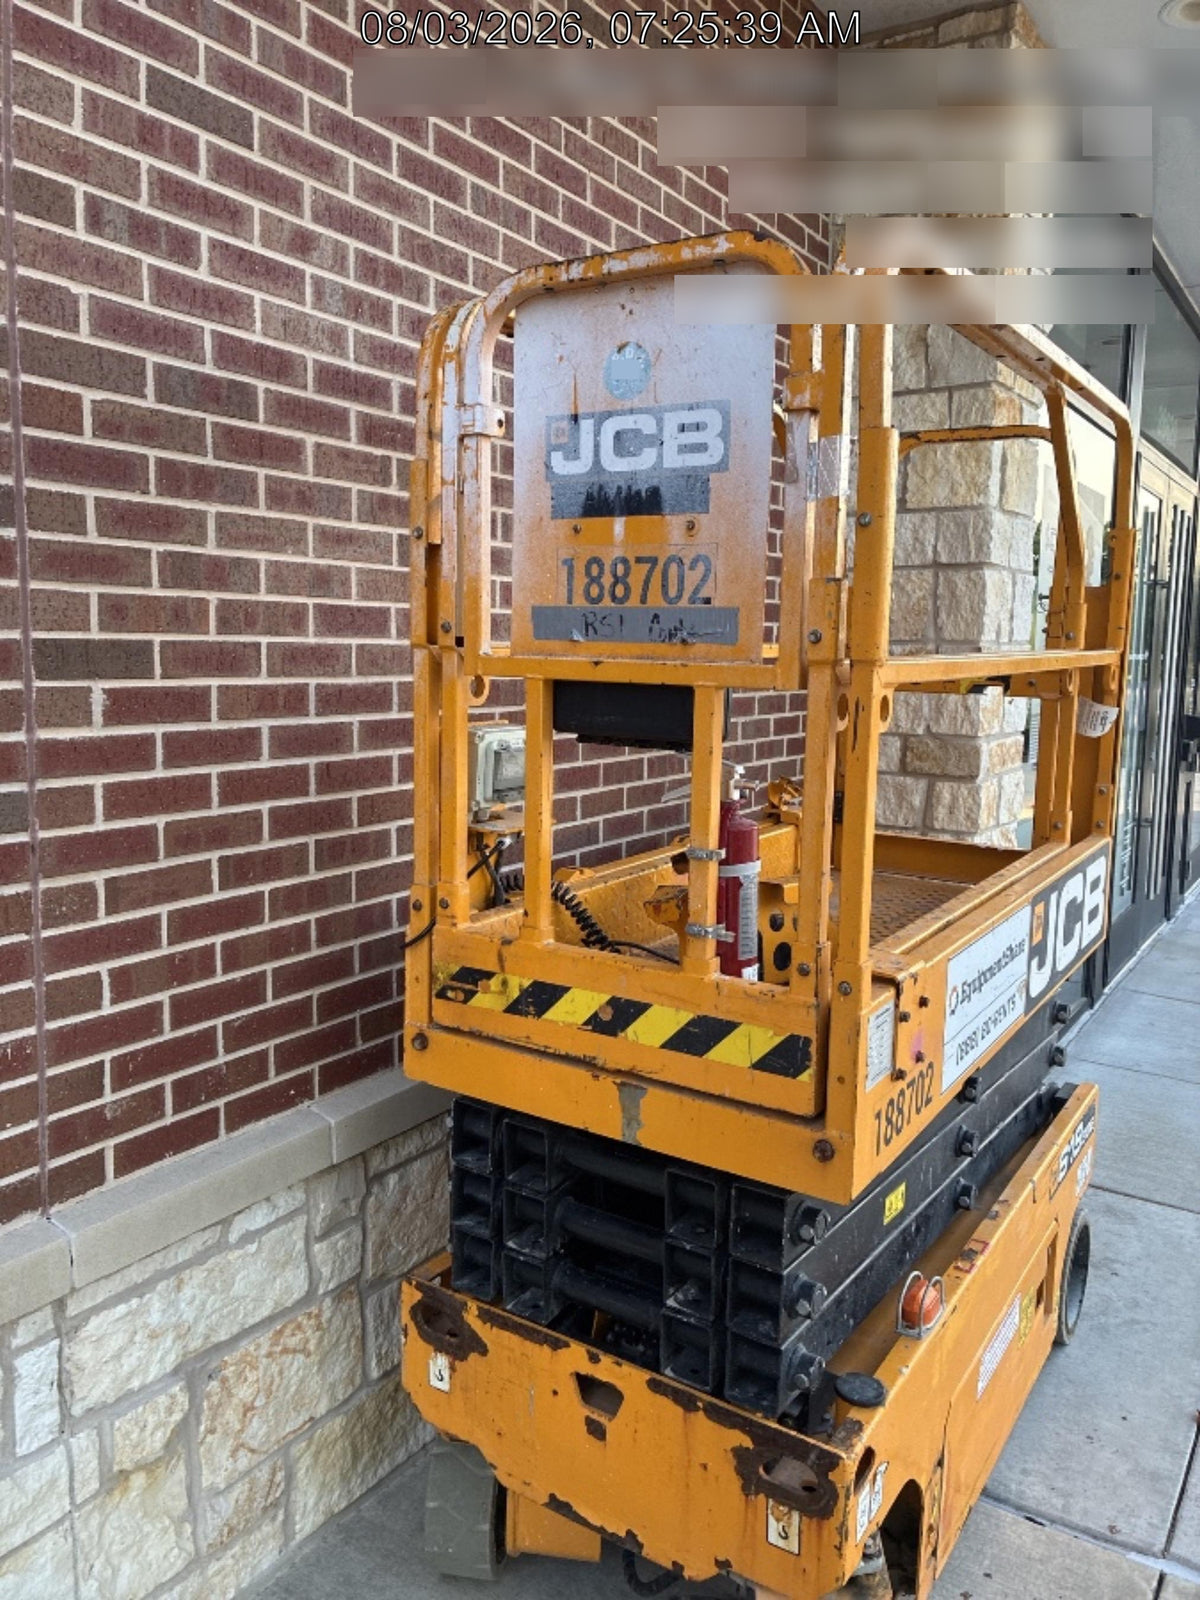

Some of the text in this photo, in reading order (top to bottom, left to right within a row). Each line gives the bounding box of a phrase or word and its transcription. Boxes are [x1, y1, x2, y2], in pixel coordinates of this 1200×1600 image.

[550, 408, 724, 475] JCB
[560, 554, 713, 605] 188702
[1030, 855, 1107, 998] JCB
[874, 1060, 935, 1157] 188702
